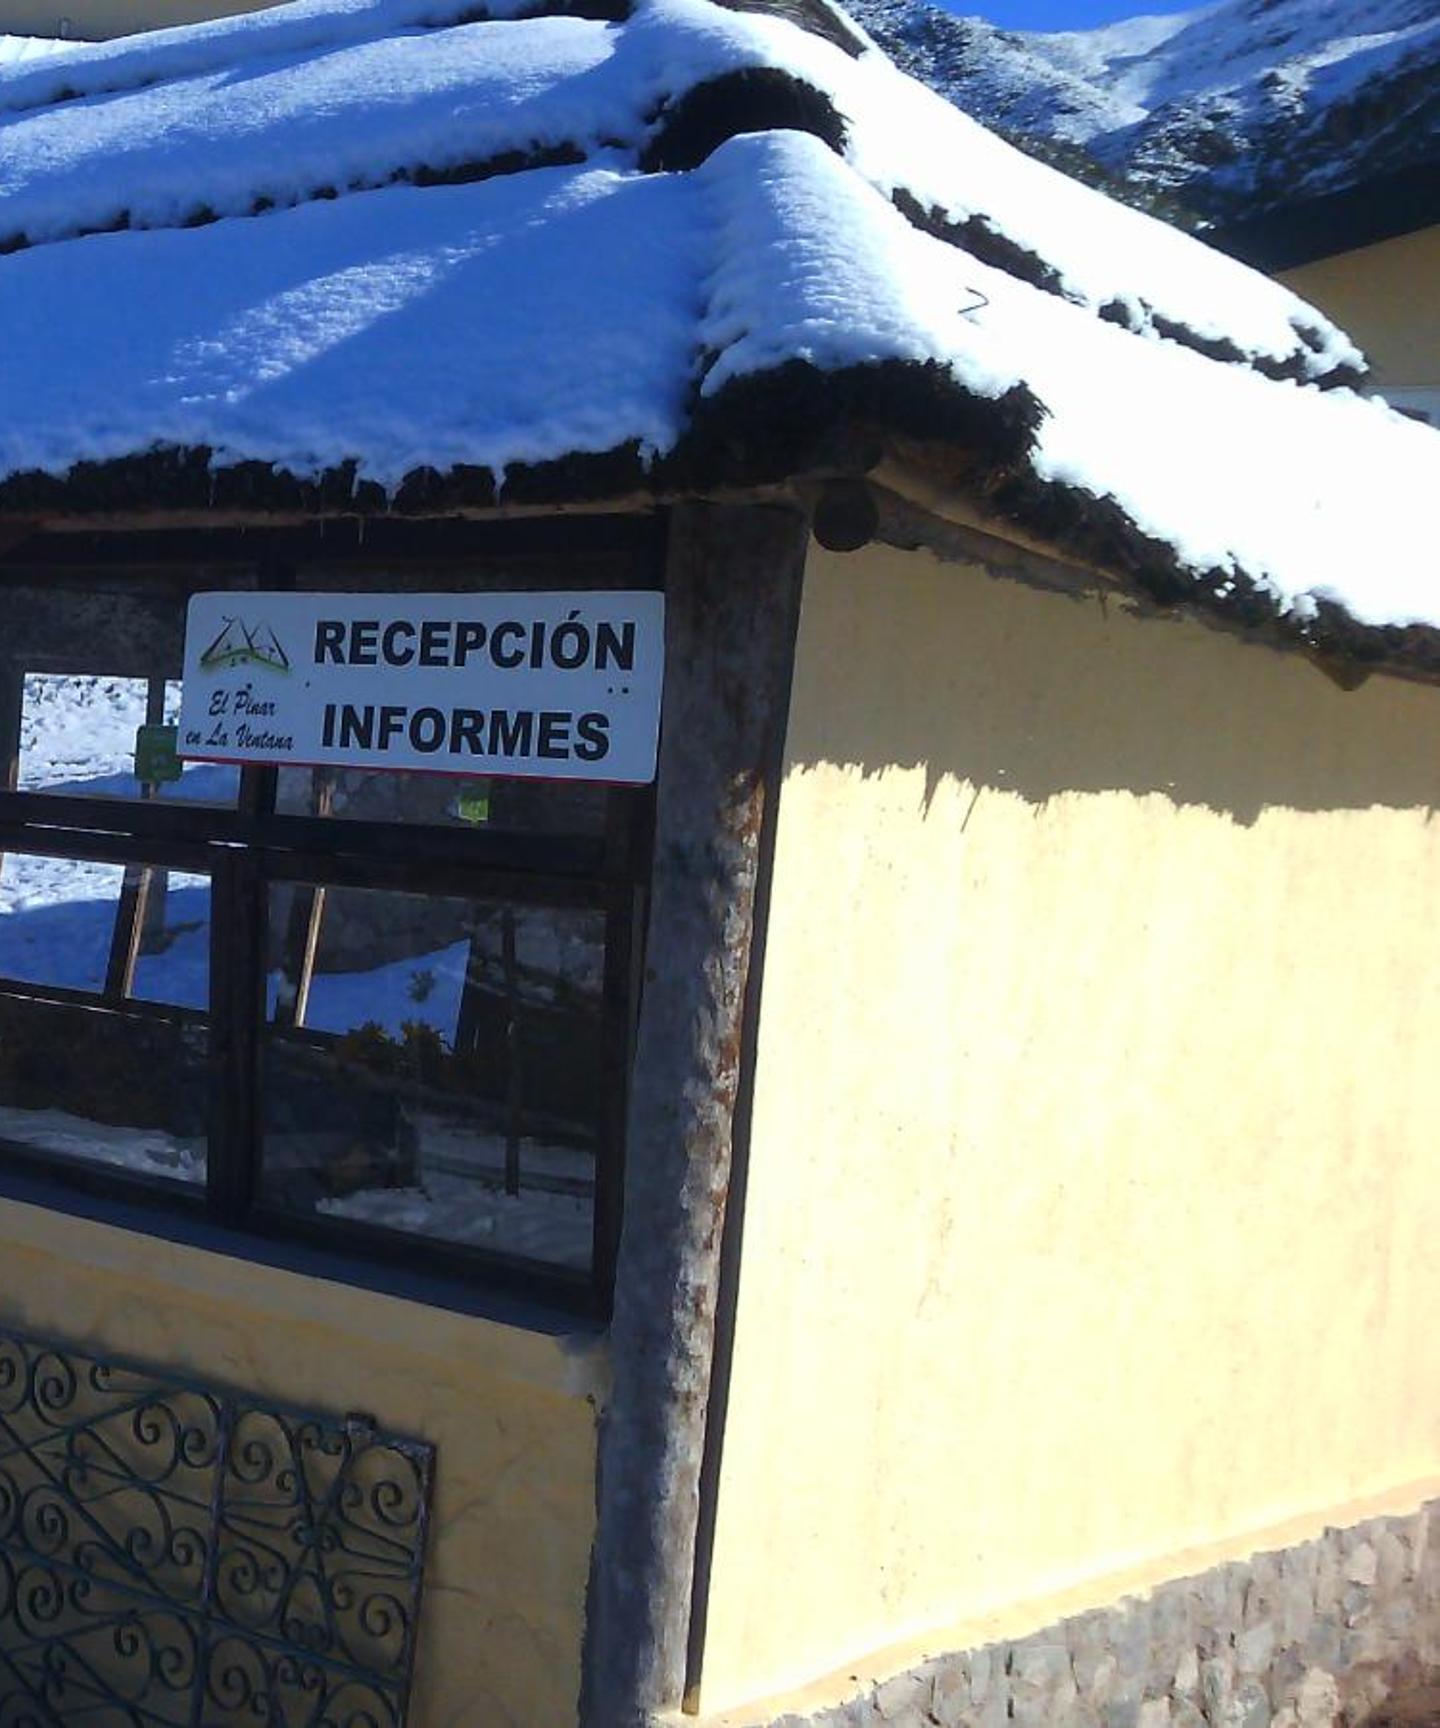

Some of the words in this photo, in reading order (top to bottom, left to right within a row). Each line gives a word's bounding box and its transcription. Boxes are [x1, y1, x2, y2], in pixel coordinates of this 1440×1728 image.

[313, 609, 636, 672] RECEPCIÓN
[208, 690, 230, 716] El
[233, 689, 276, 717] Pinar
[185, 731, 202, 746] en
[205, 721, 229, 748] La
[235, 723, 294, 752] Ventana
[321, 703, 610, 762] INFORMES
